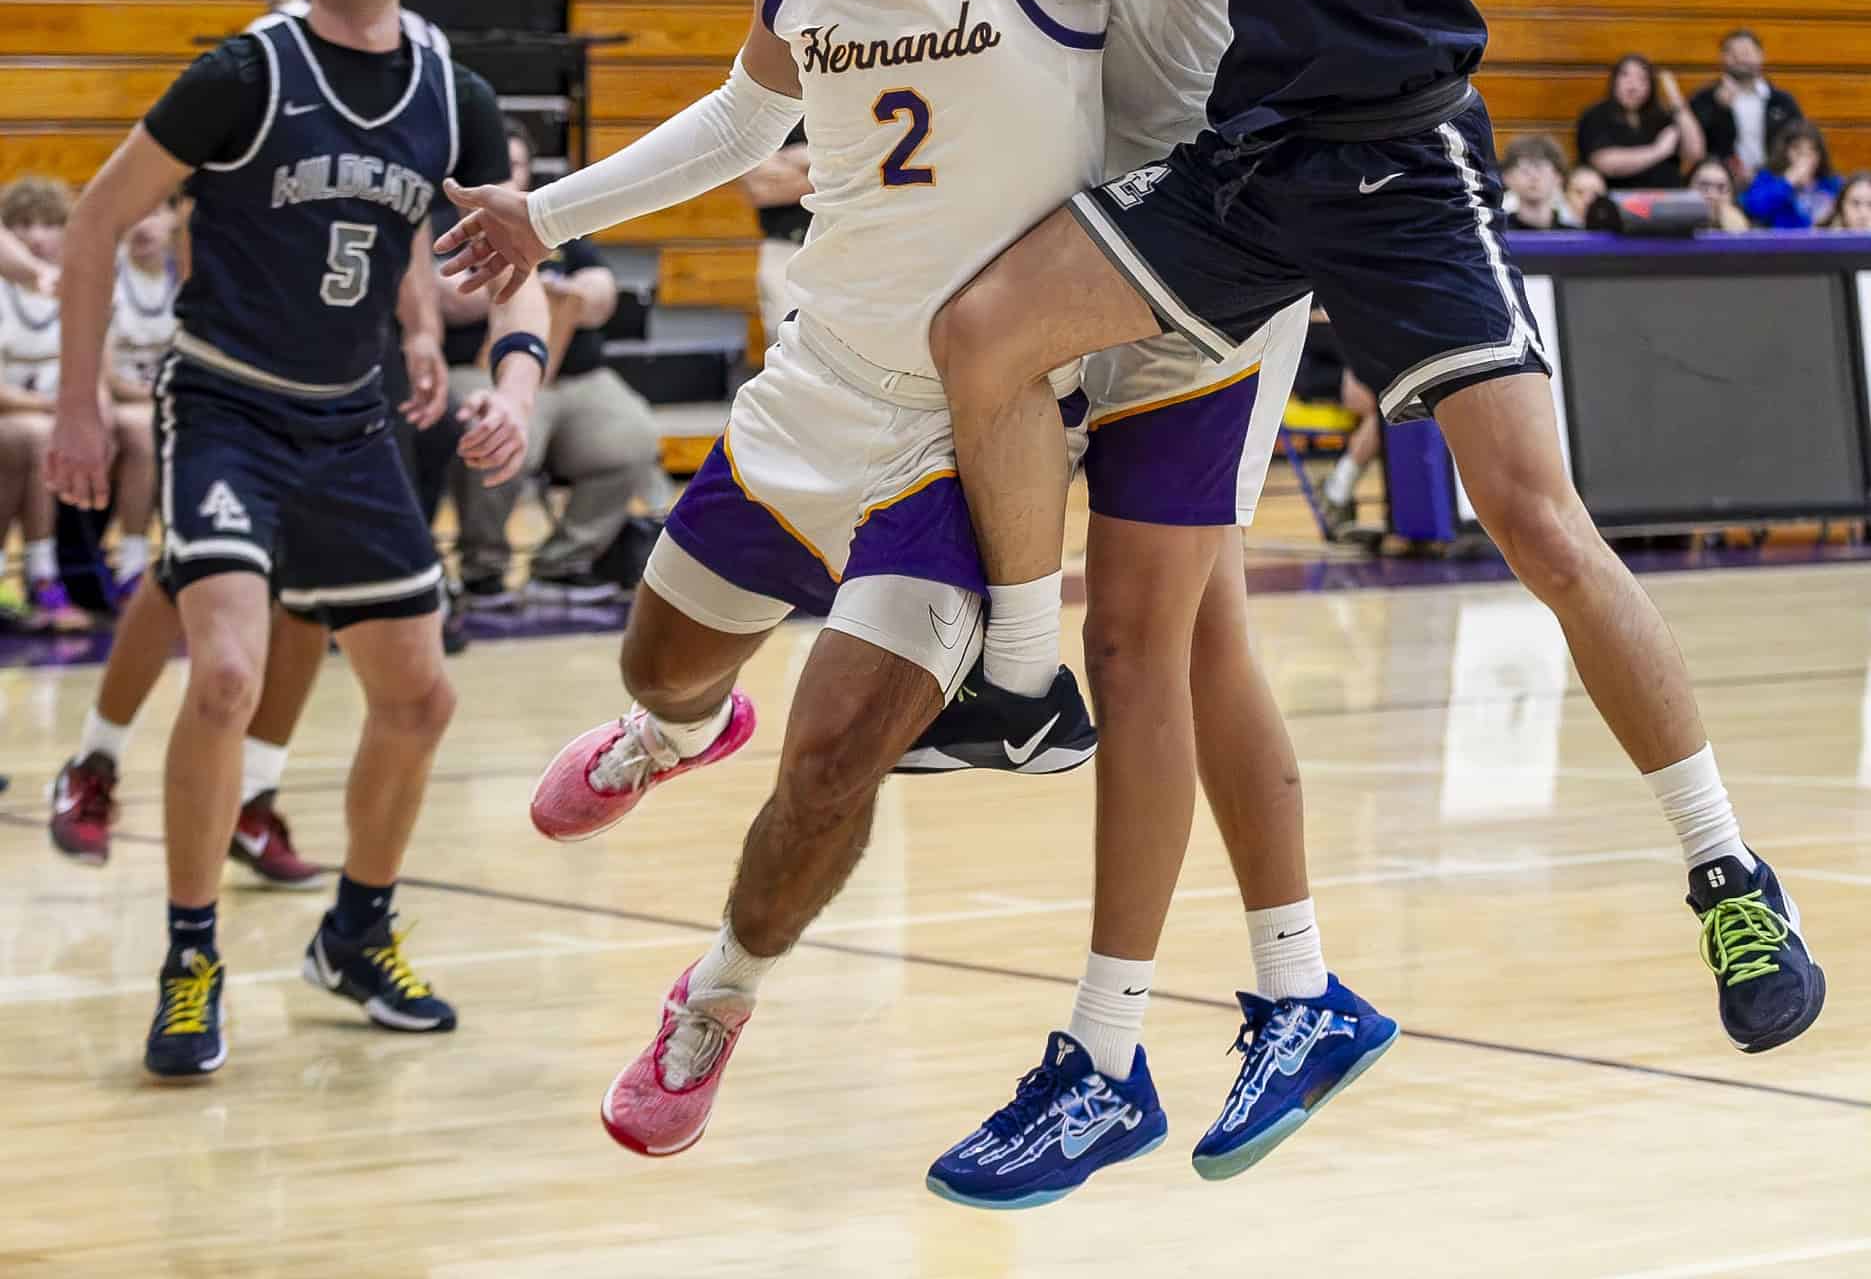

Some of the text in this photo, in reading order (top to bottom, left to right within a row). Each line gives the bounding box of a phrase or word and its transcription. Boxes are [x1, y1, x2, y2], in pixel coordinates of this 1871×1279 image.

[801, 0, 1001, 73] Hernando
[871, 86, 936, 189] 2
[270, 152, 436, 225] WILDCATS
[319, 220, 378, 306] 5
